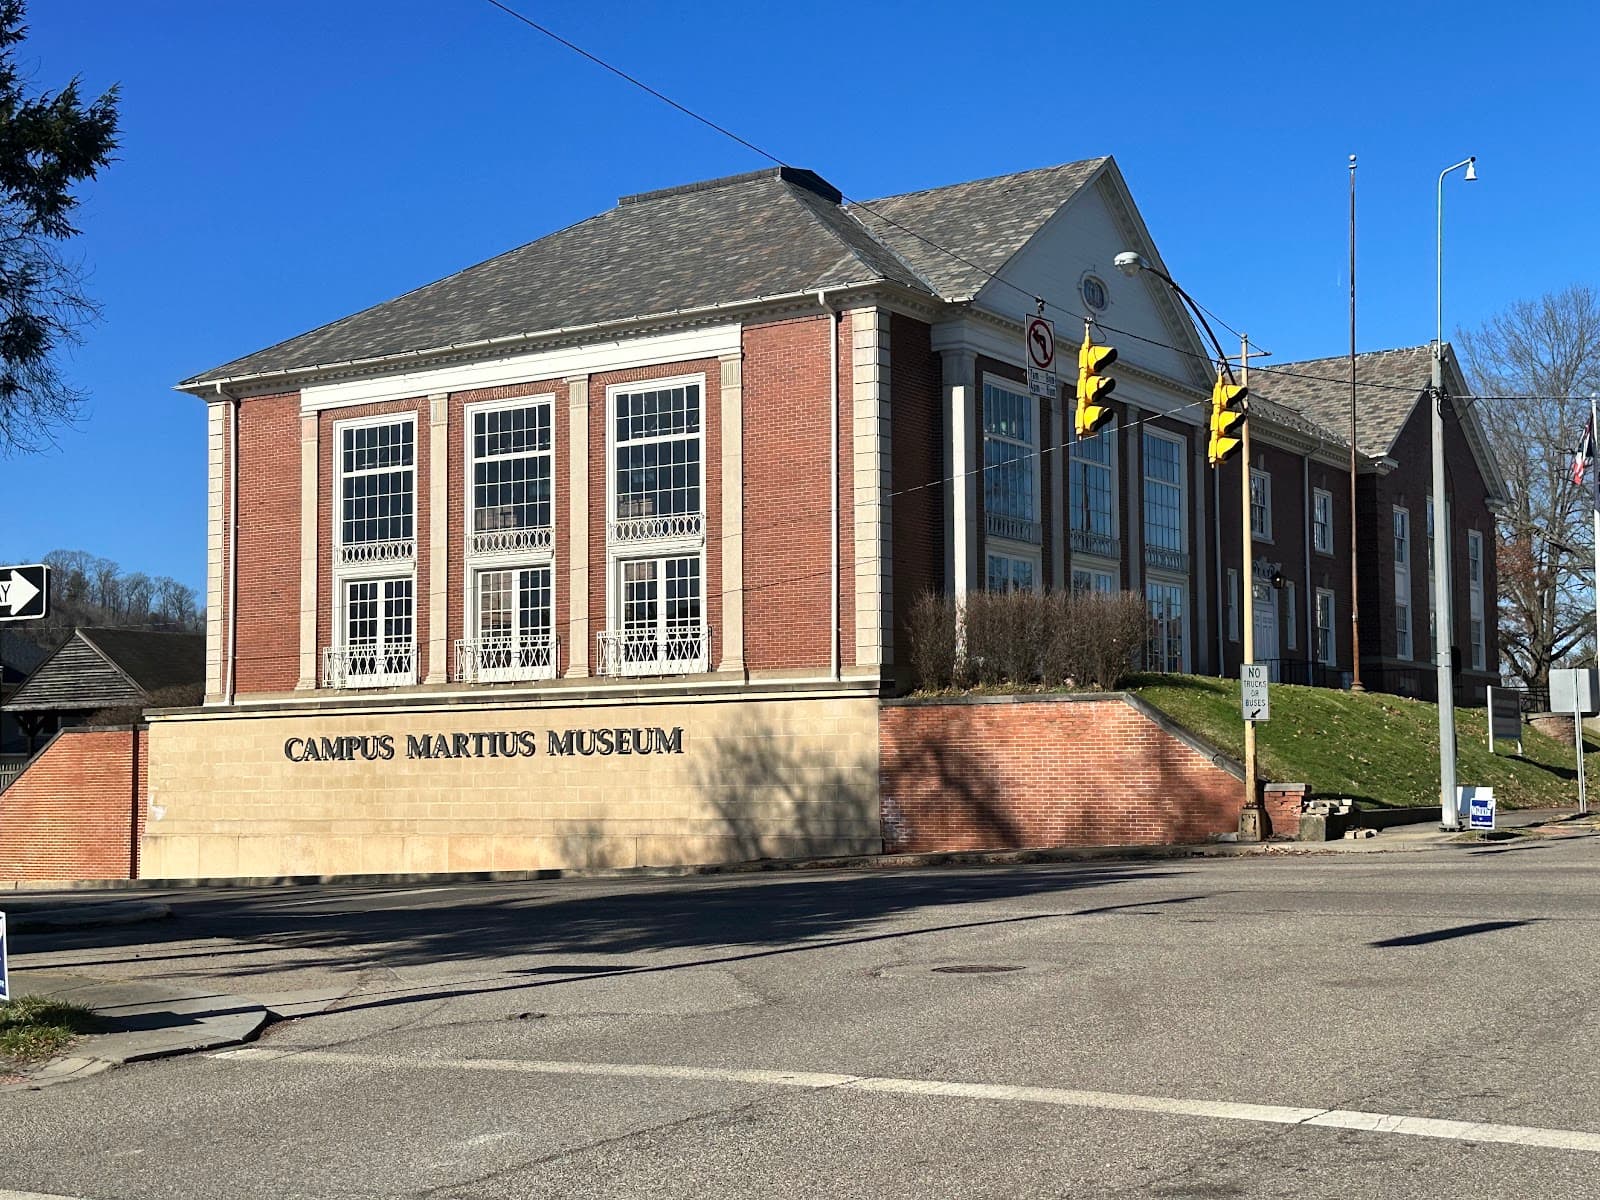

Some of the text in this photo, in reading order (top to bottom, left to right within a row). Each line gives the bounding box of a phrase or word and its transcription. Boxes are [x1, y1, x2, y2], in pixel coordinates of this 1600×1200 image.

[1248, 667, 1261, 678] NO
[1243, 680, 1267, 689] TRUCKS
[1245, 699, 1266, 707] BUSES
[284, 726, 685, 762] CAMPUS MARTIUS MUSEUM
